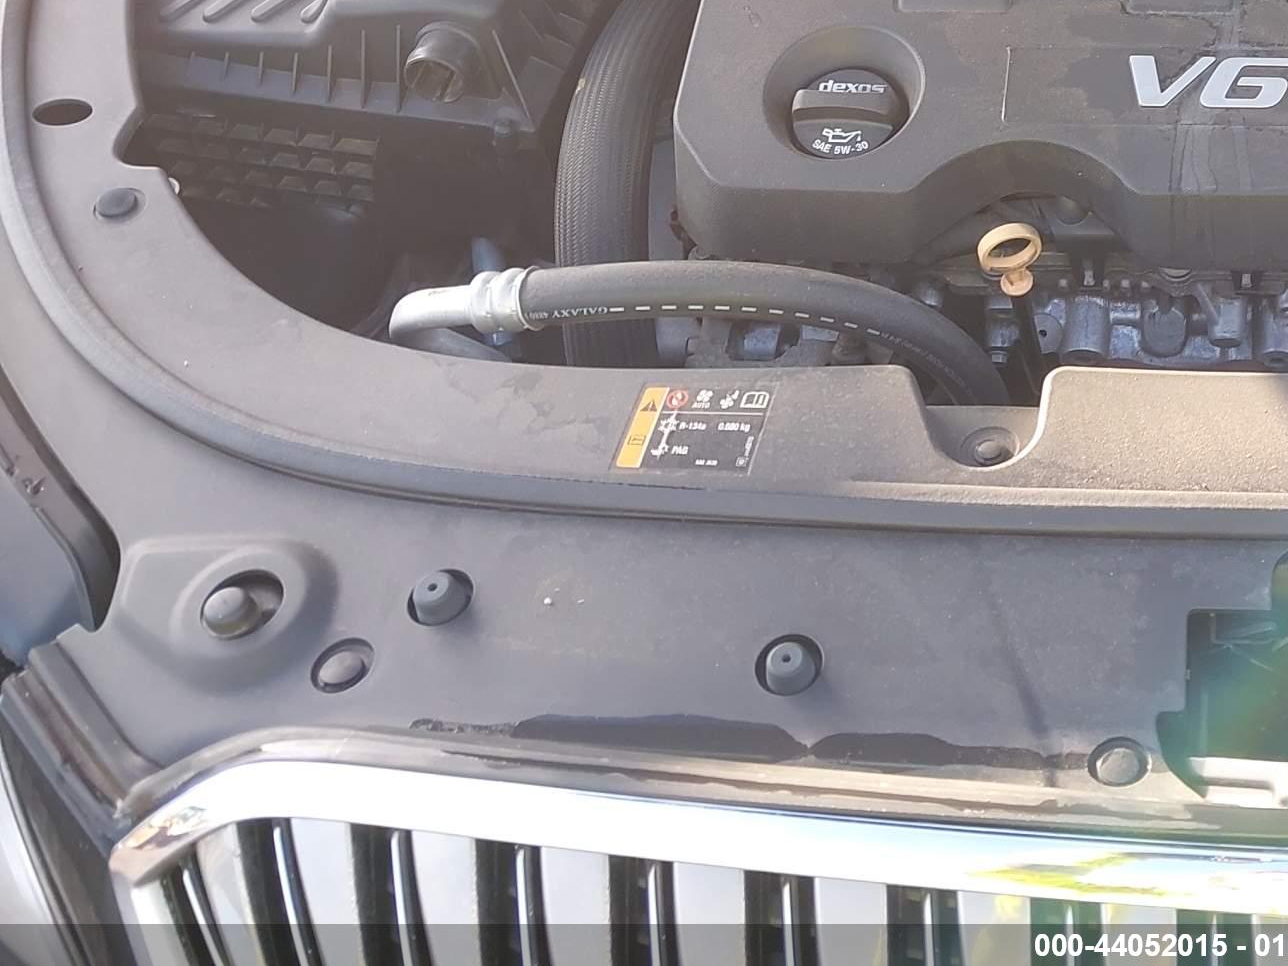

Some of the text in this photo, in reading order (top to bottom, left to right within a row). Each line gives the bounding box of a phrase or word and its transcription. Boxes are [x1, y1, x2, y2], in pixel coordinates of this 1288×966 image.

[819, 79, 888, 94] dexos
[812, 139, 869, 154] SAE 5W-30
[552, 306, 608, 318] GALAXY
